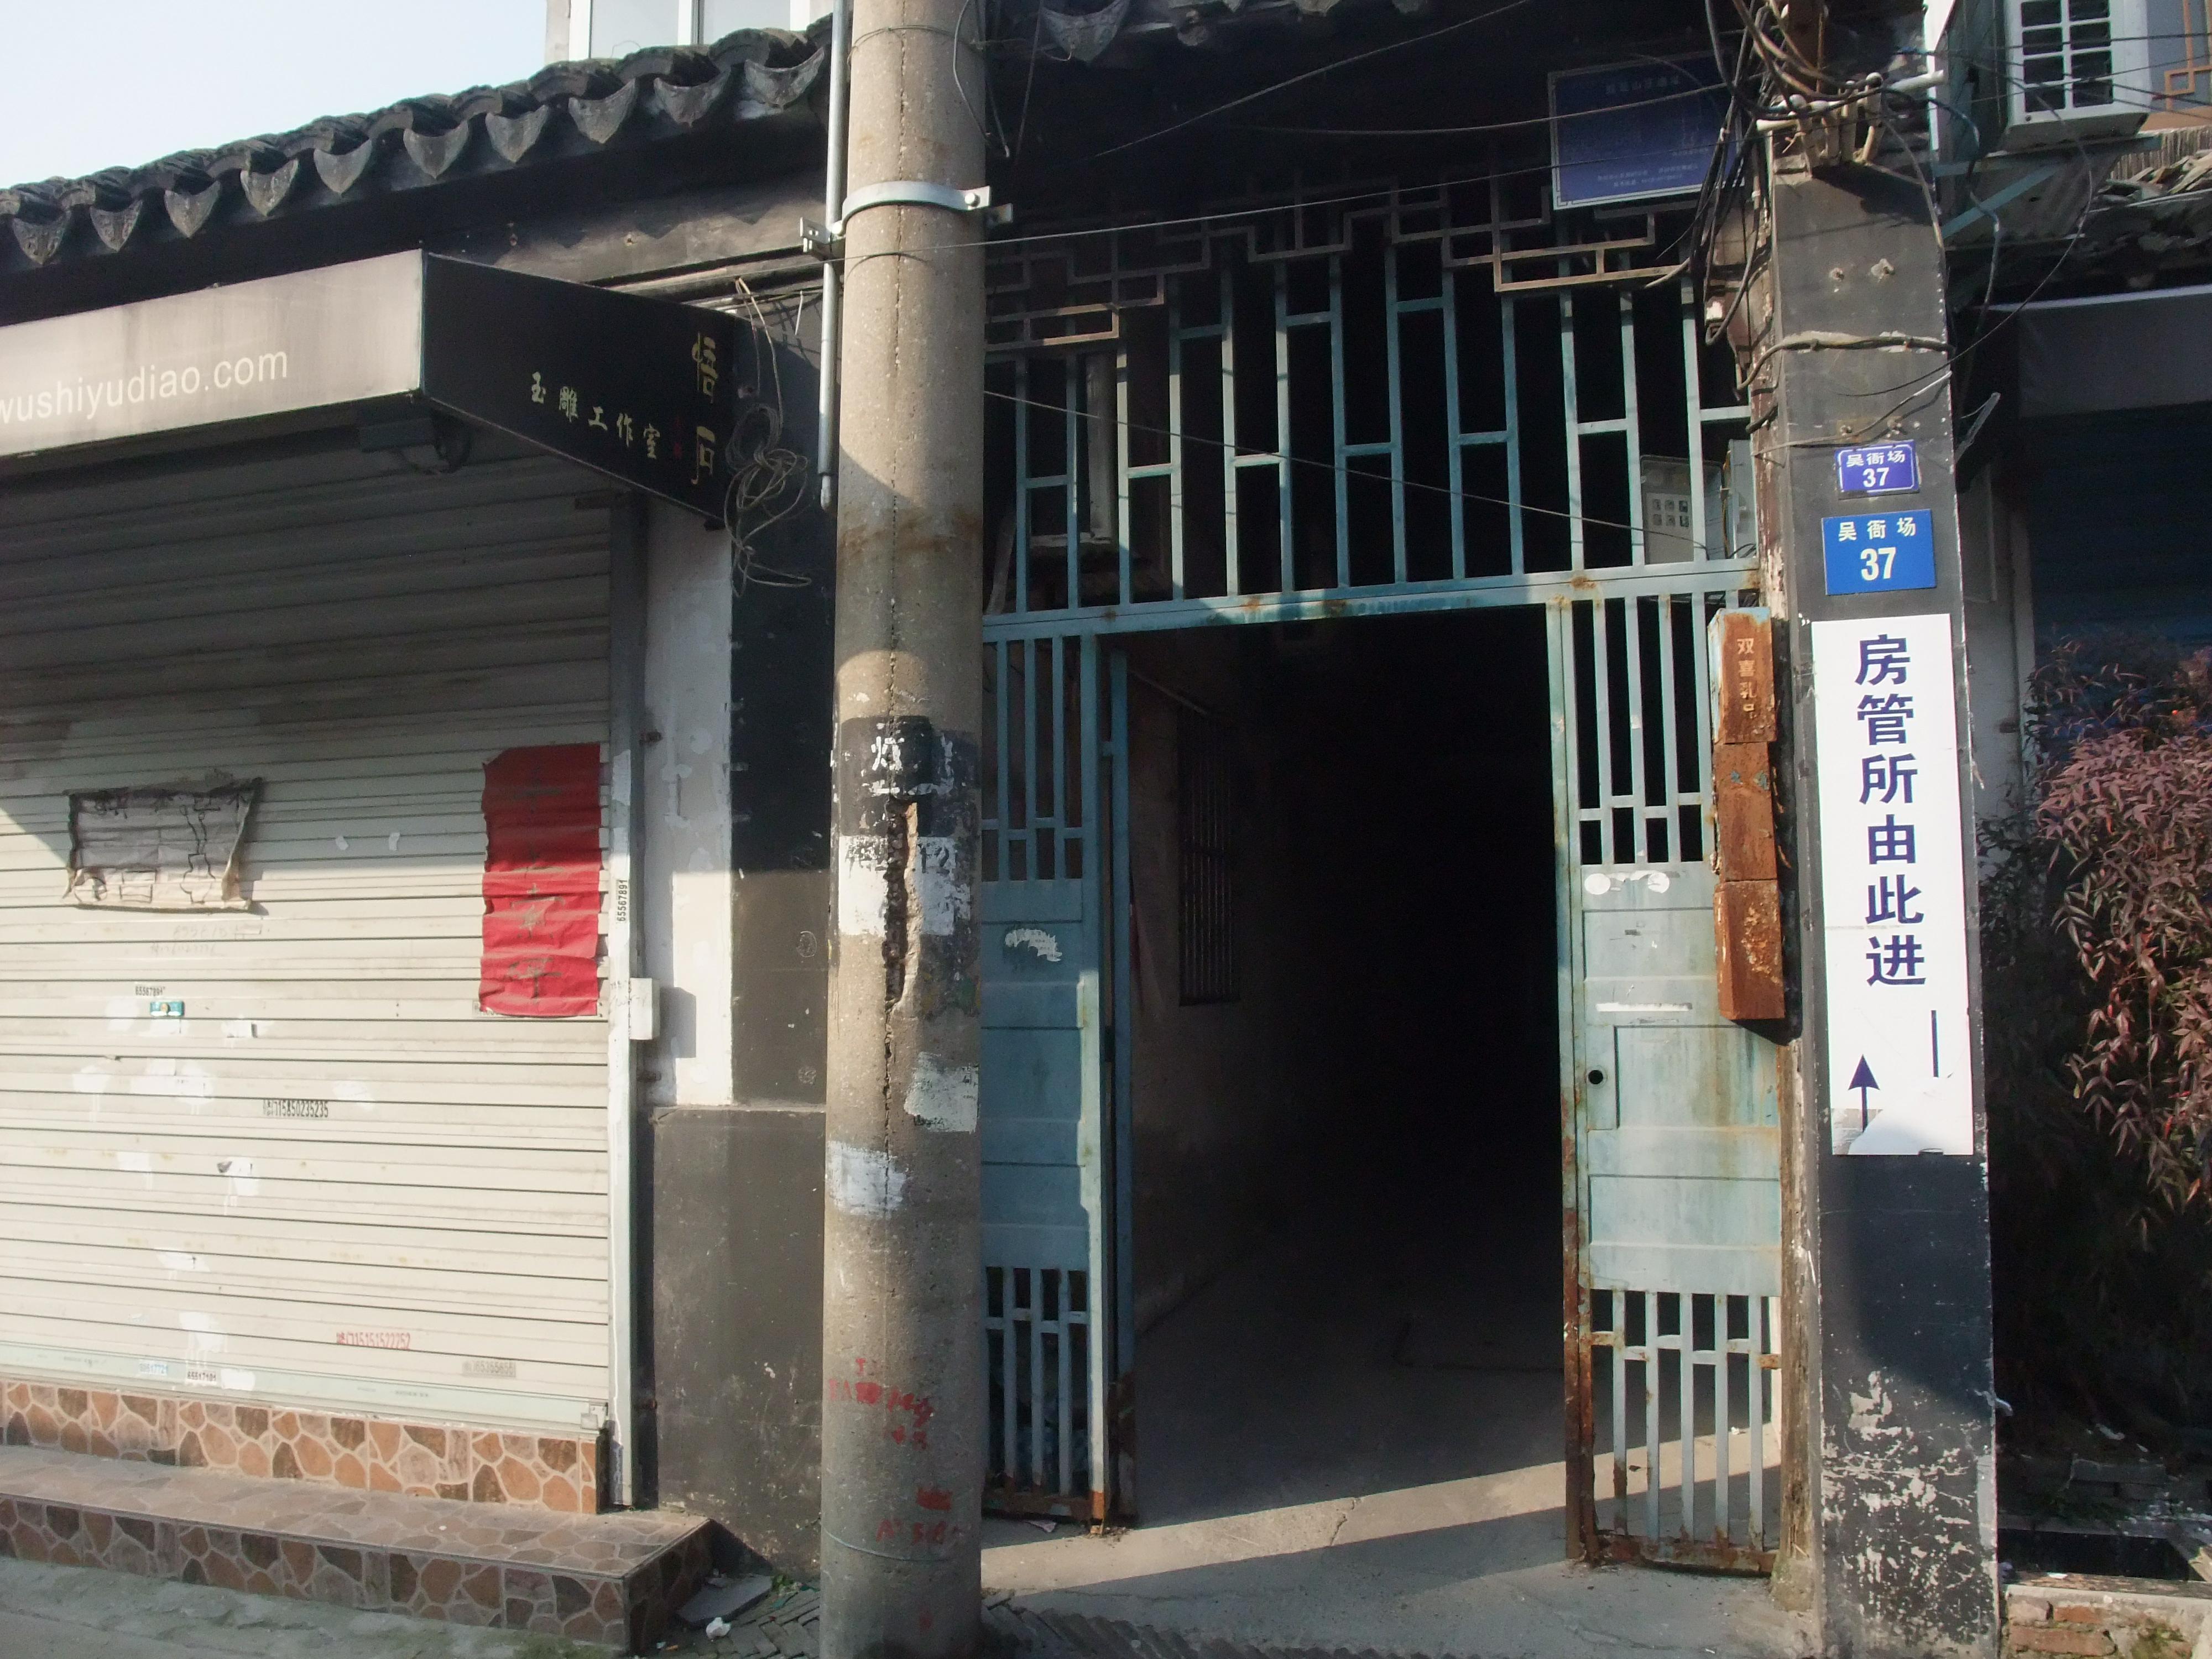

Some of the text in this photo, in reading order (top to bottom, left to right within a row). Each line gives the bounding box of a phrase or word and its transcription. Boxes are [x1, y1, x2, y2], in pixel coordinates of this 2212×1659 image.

[0, 350, 288, 424] wushiyudiao.com
[531, 371, 660, 460] 玉雕工作室
[1846, 450, 1906, 468] 吴衙场
[1863, 467, 1890, 488] 37
[1838, 517, 1916, 542] 吴衙场
[1860, 546, 1896, 581] 37
[1854, 634, 1927, 988] 房管所由此进
[616, 879, 628, 922] 65567891
